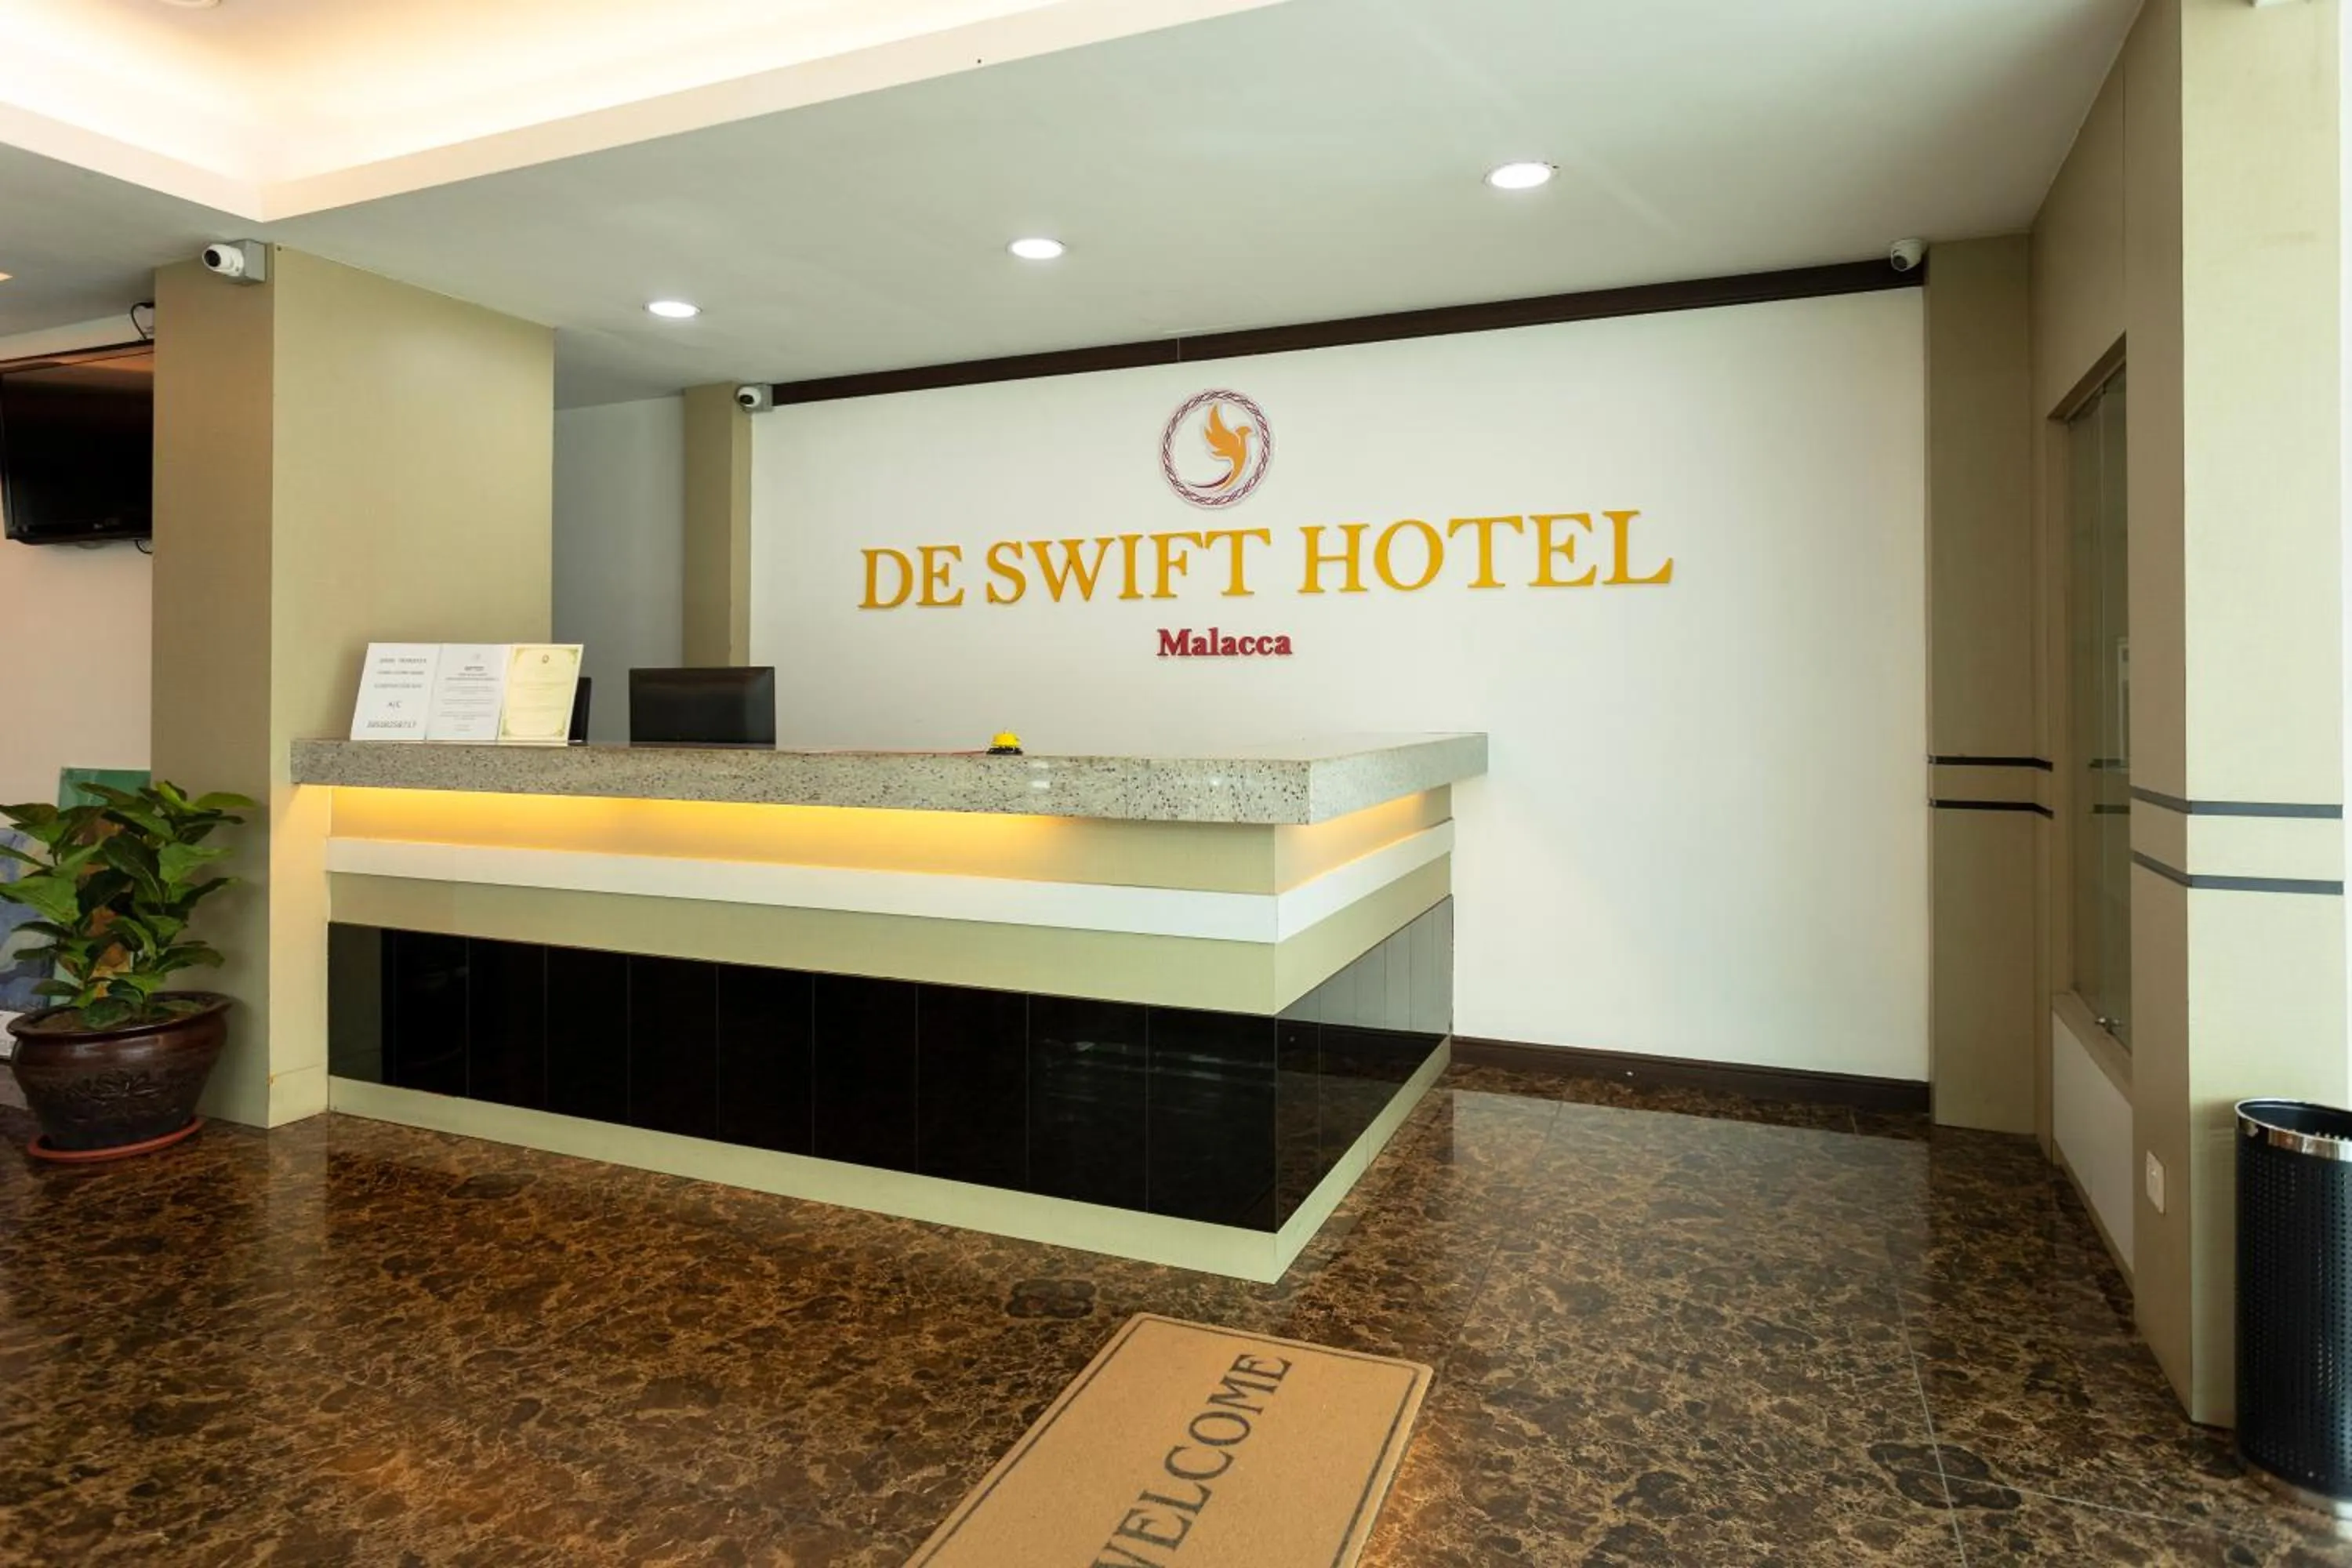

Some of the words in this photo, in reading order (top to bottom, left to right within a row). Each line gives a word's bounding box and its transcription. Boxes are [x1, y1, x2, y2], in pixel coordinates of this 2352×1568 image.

[858, 544, 964, 610] DE
[986, 528, 1272, 605] SWIFT
[1298, 510, 1675, 594] HOTEL
[1156, 628, 1293, 658] Malacca
